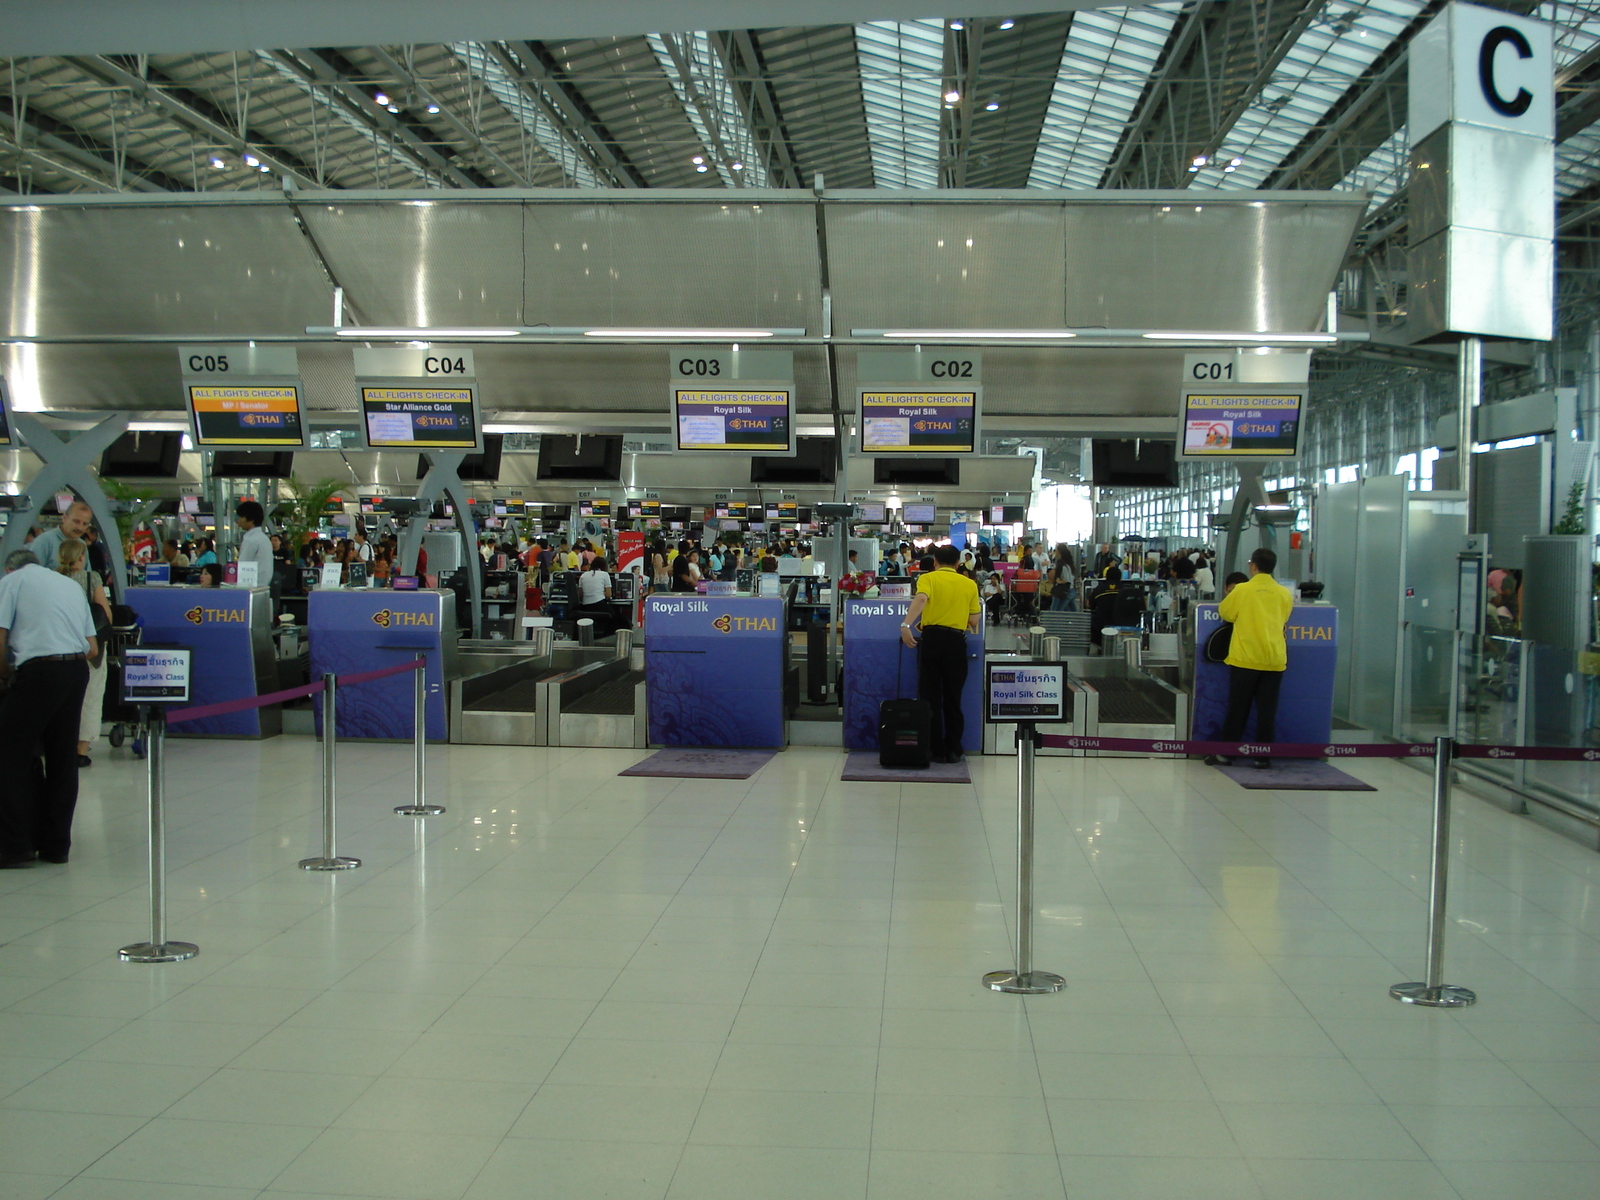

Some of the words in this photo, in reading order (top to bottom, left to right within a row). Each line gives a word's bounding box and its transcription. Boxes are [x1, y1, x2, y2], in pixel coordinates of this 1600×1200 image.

[1478, 25, 1534, 118] C
[189, 355, 229, 372] C05
[425, 357, 466, 374] C04
[679, 359, 721, 376] C03
[931, 360, 973, 378] C02
[1193, 362, 1233, 380] C01
[367, 391, 383, 399] ALL
[386, 391, 423, 399] FLIGHTS
[700, 394, 738, 402] FLIGHTS
[1191, 398, 1208, 406] ALL
[1211, 398, 1249, 406] FLIGHTS
[1252, 398, 1296, 406] CHECK-IN
[385, 403, 400, 411] Star
[402, 403, 432, 411] Alliance
[713, 406, 736, 415] Royal
[737, 406, 752, 414] Silk
[899, 408, 921, 417] Royal
[922, 408, 937, 416] Silk
[1222, 411, 1245, 419] Royal
[255, 415, 279, 424] THAI
[428, 417, 453, 426] THAI
[742, 420, 767, 428] THAI
[927, 422, 952, 430] THAI
[1250, 425, 1276, 433] THAI
[652, 601, 684, 614] Royal
[688, 601, 708, 612] Silk
[852, 604, 884, 617] Royal
[204, 609, 245, 623] THAI
[392, 612, 434, 626] THAI
[733, 617, 776, 631] THAI
[1288, 626, 1332, 640] THAI
[127, 673, 148, 681] Royal
[1000, 673, 1015, 681] THAI
[993, 691, 1017, 699] Royal
[1080, 739, 1100, 747] THAI
